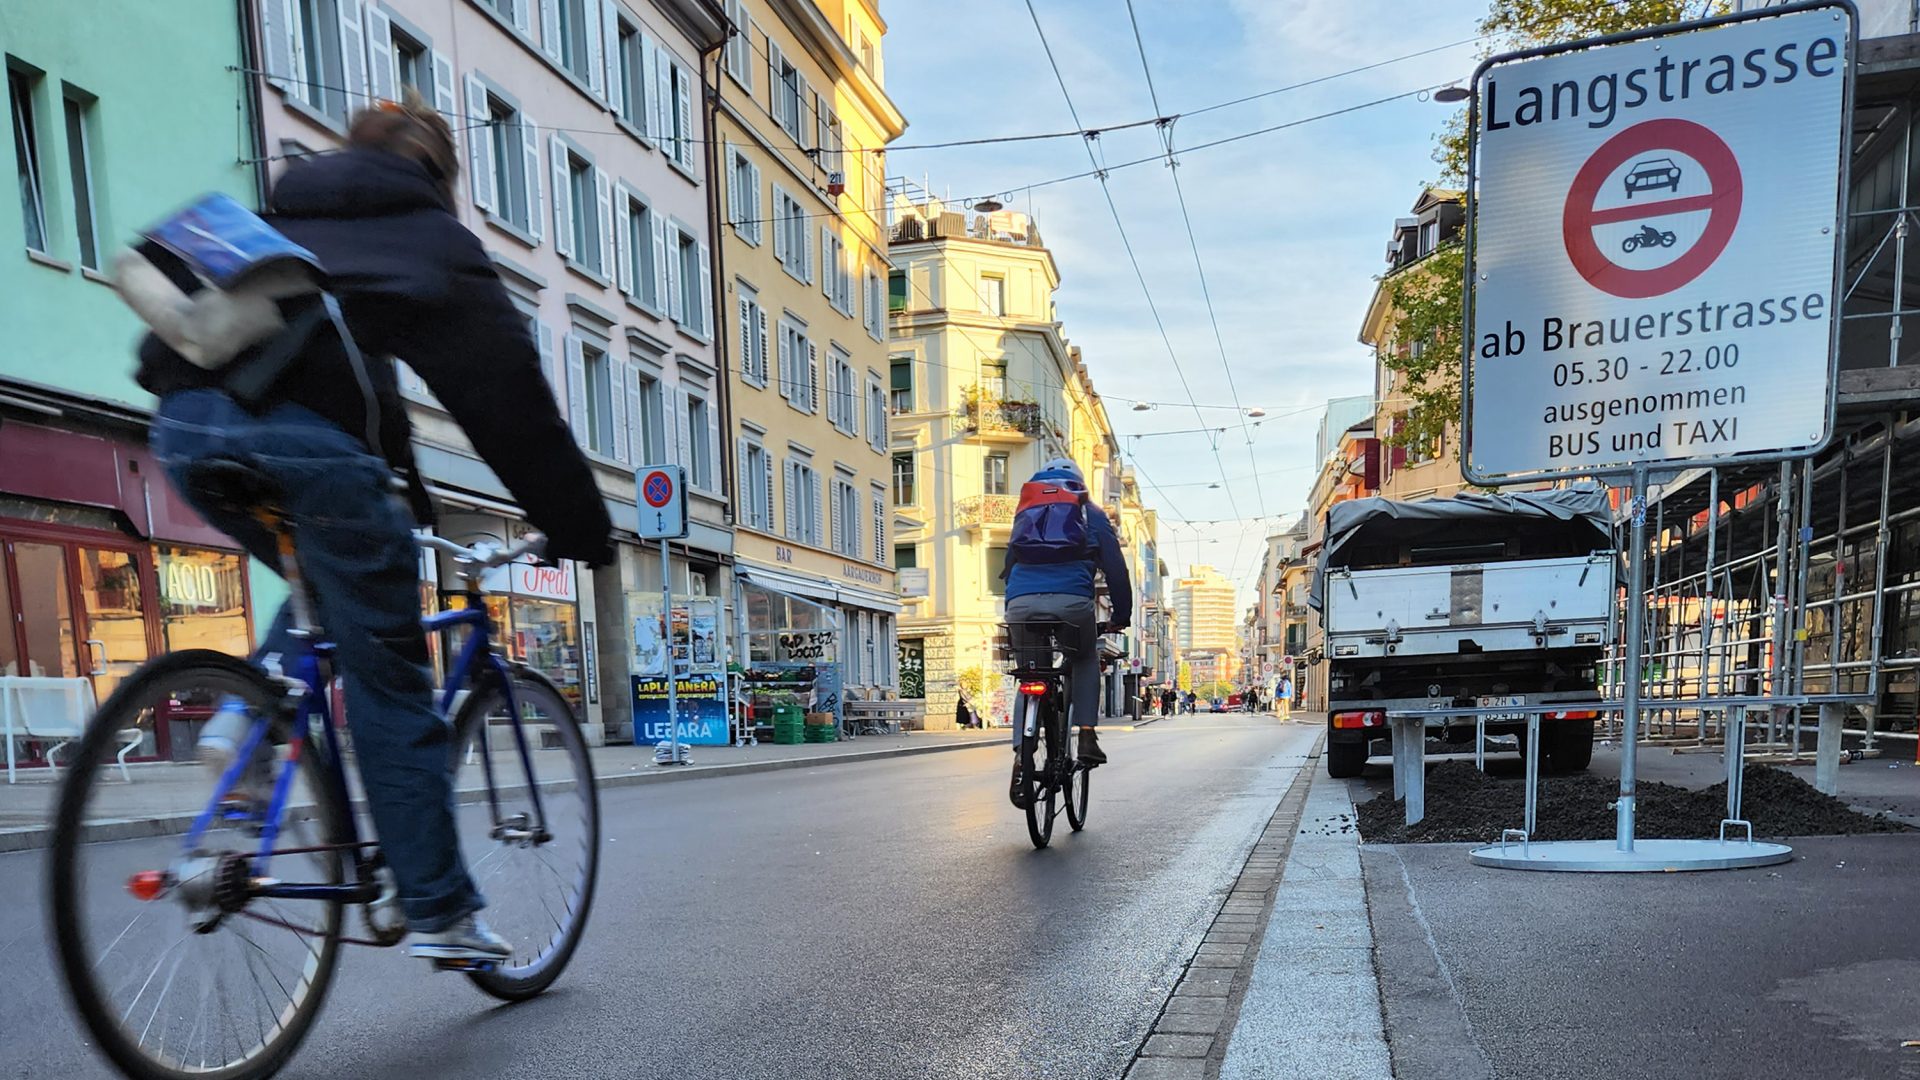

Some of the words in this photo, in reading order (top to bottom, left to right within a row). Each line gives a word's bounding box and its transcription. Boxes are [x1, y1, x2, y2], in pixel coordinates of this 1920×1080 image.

[1486, 36, 1837, 131] Langstrasse
[1480, 320, 1526, 359] ab
[1542, 292, 1825, 351] Brauerstrasse
[1553, 356, 1629, 387] 05.30
[1660, 343, 1739, 376] 22.00
[1543, 385, 1747, 425] ausgenommen
[1549, 431, 1600, 458] BUS
[1611, 423, 1662, 452] und
[1673, 417, 1738, 446] TAXI
[776, 546, 792, 564] BAR
[169, 562, 216, 602] ACID
[1495, 697, 1507, 706] ZH
